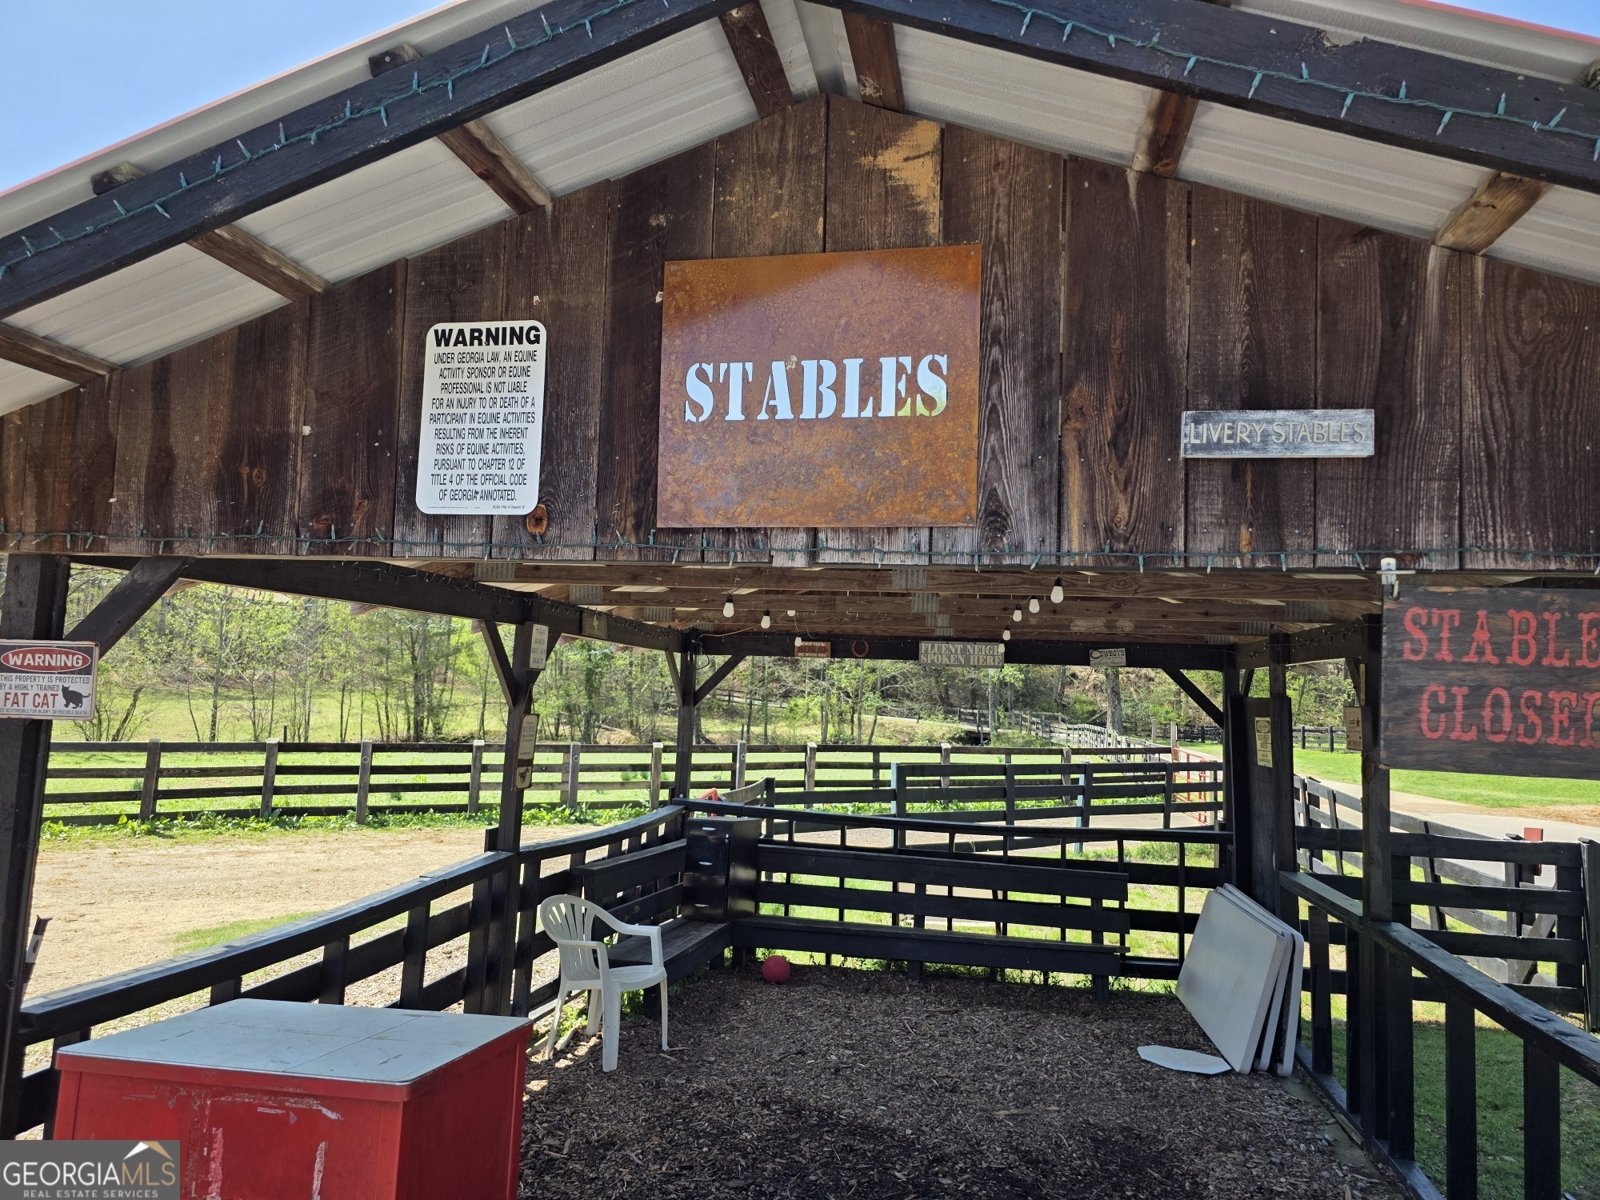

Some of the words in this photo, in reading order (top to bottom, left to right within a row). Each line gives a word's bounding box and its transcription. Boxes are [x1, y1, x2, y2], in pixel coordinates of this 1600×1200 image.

[434, 326, 540, 347] WARNING
[434, 353, 455, 364] UNDER
[457, 352, 484, 363] GEORGIA
[503, 351, 512, 362] AN
[515, 350, 537, 362] EQUINE
[439, 368, 465, 379] ACTIVITY
[467, 367, 495, 378] SPONSOR
[498, 367, 506, 378] OR
[509, 366, 530, 377] EQUINE
[441, 382, 484, 394] PROFESSIONAL
[486, 382, 491, 393] IS
[494, 382, 505, 393] NOT
[508, 381, 527, 392] LIABLE
[684, 354, 948, 422] STABLES
[432, 398, 443, 409] FOR
[446, 398, 454, 409] AN
[457, 398, 477, 409] INJURY
[479, 398, 486, 408] TO
[489, 397, 497, 408] OR
[500, 397, 518, 408] DEATH
[521, 397, 529, 408] OF
[531, 397, 535, 408] A
[429, 413, 467, 424] PARTICIPANT
[469, 413, 475, 424] IN
[478, 412, 500, 424] EQUINE
[503, 412, 535, 424] ACTIVITIES
[434, 428, 465, 440] RESULTING
[468, 428, 484, 439] FROM
[486, 428, 497, 439] THE
[500, 428, 528, 439] INHERENT
[1190, 422, 1266, 444] LIVERY
[1272, 421, 1365, 444] STABLES
[436, 443, 454, 455] RISKS
[457, 443, 465, 454] OF
[467, 443, 489, 454] EQUINE
[492, 443, 525, 456] ACTIVITIES,
[434, 459, 466, 470] PURSUANT
[468, 459, 475, 470] TO
[478, 459, 505, 470] CHAPTER
[508, 459, 514, 470] 12
[517, 458, 525, 470] OF
[431, 474, 446, 485] TITLE
[449, 474, 453, 485] 4
[456, 474, 464, 485] OF
[467, 474, 478, 485] THE
[480, 474, 507, 485] OFFICIAL
[510, 474, 527, 485] CODE
[439, 489, 447, 500] OF
[450, 489, 478, 500] GEORGIA
[480, 489, 516, 500] ANNOTATED.
[922, 643, 963, 654] FLUENT
[8, 654, 82, 667] WARNING
[921, 654, 965, 664] SPOKEN
[970, 656, 1002, 665] HERE
[55, 676, 90, 684] PROTECTED
[4, 692, 28, 707] FAT
[33, 693, 58, 708] CAT
